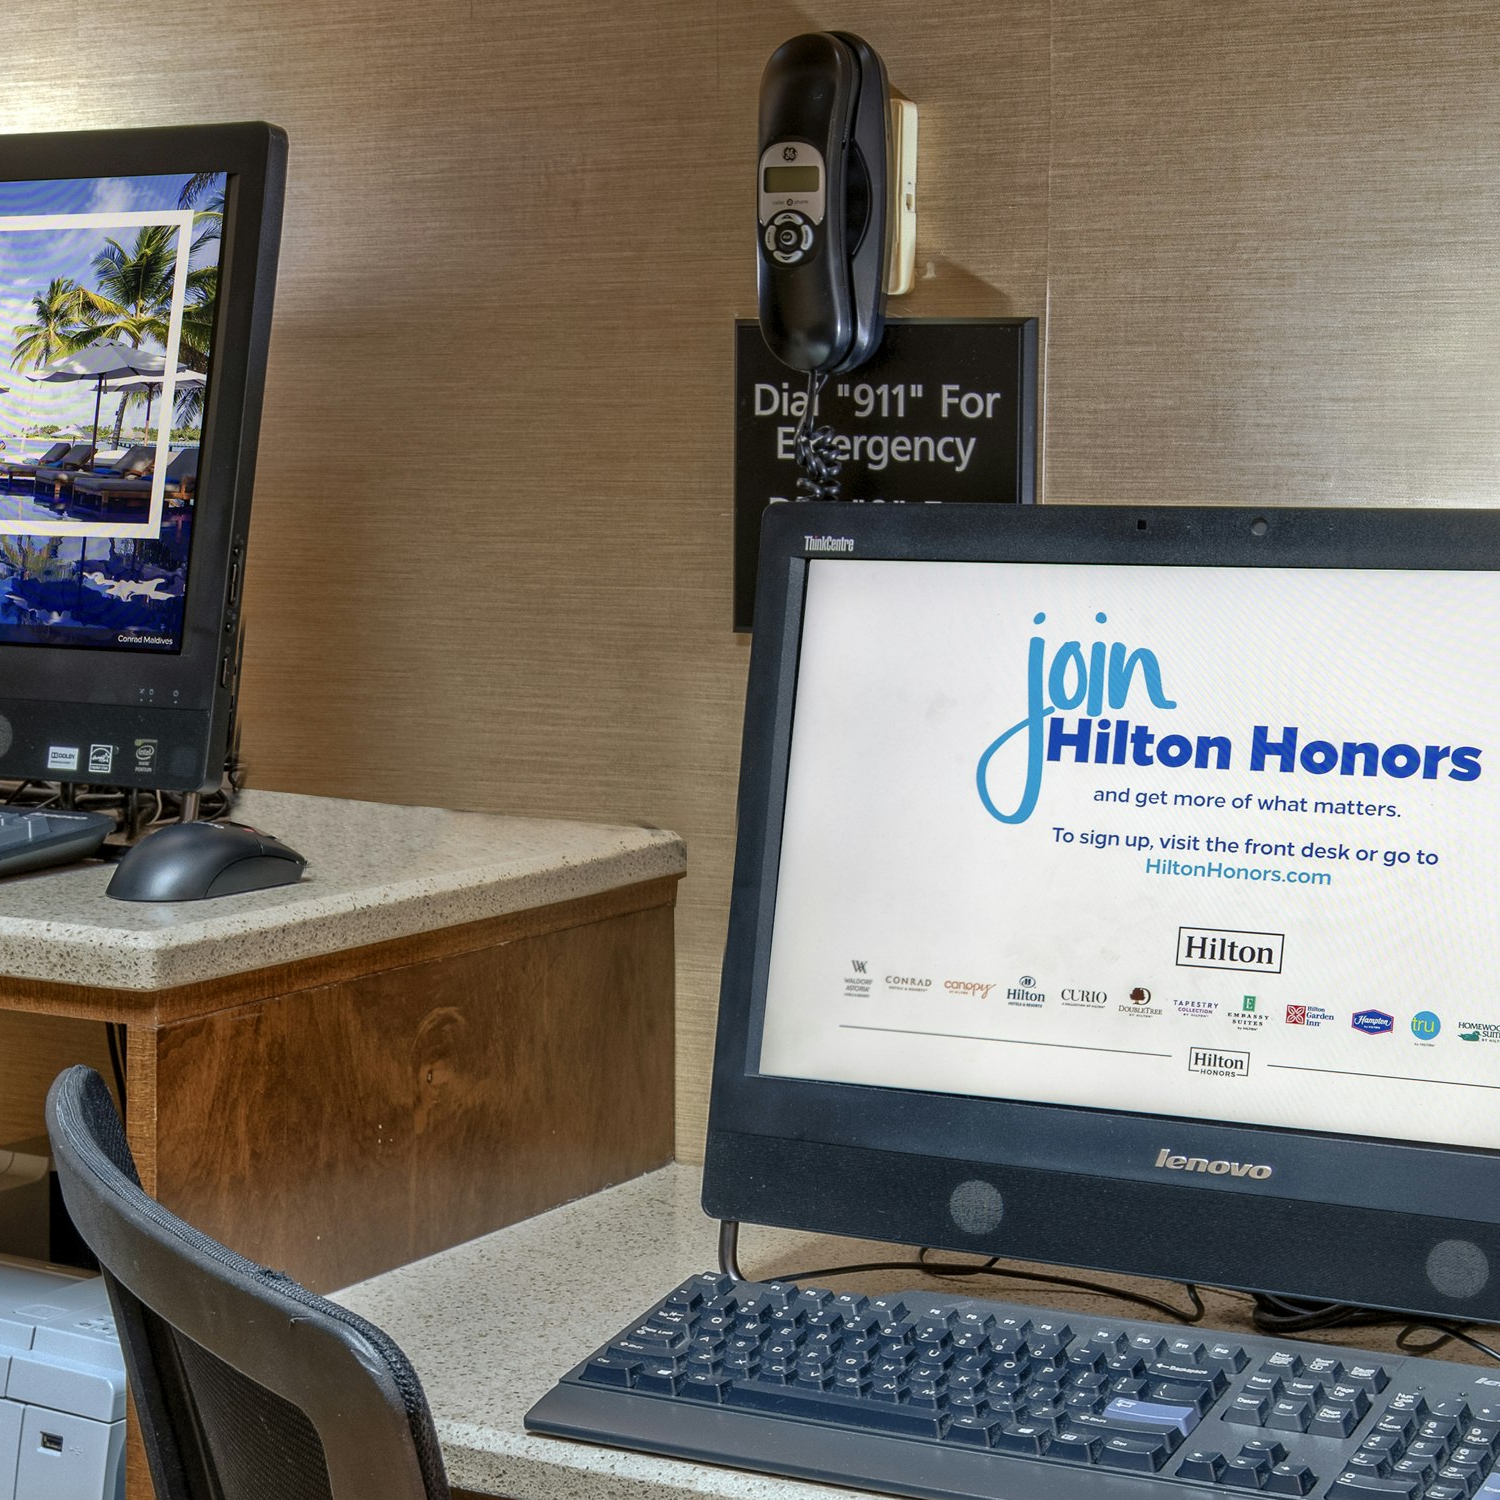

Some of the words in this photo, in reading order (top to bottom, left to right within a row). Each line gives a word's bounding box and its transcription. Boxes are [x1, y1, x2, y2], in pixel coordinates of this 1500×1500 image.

[837, 384, 923, 417] "911"
[941, 384, 1000, 418] For
[777, 426, 976, 472] Eergency
[804, 535, 854, 552] ThinkCentre
[117, 635, 143, 645] Conrad
[143, 636, 173, 646] Maldives
[976, 612, 1177, 824] join
[1046, 717, 1232, 771] Hilton
[1249, 725, 1483, 782] Honors
[1093, 788, 1130, 803] and
[1135, 790, 1168, 807] get
[1173, 793, 1226, 808] more
[1231, 794, 1253, 809] of
[1258, 796, 1308, 812] what
[1314, 800, 1401, 818] matters.
[1052, 827, 1074, 843] To
[1079, 830, 1120, 849] sign
[1125, 835, 1154, 851] up,
[1159, 834, 1200, 851] visit
[1206, 836, 1239, 853] the
[1244, 839, 1295, 857] front
[1301, 842, 1350, 860] desk
[1356, 849, 1379, 862] or
[1383, 850, 1411, 867] go
[1416, 849, 1439, 865] to
[1146, 858, 1332, 885] HiltonHonors.com
[1185, 935, 1274, 965] Hilton
[885, 975, 932, 987] CONRAD
[944, 980, 996, 999] canopy
[1007, 988, 1045, 1002] Hilton
[1061, 988, 1107, 1003] CURIO
[1174, 1000, 1219, 1009] TAPESTRY
[1227, 1012, 1269, 1020] EMBASSY
[1306, 1012, 1334, 1020] Garden
[1354, 1015, 1392, 1026] Hampton
[1412, 1017, 1435, 1033] tru
[1193, 1052, 1244, 1070] Hilton
[1200, 1068, 1236, 1078] HONORS
[1155, 1148, 1273, 1180] lenovo
